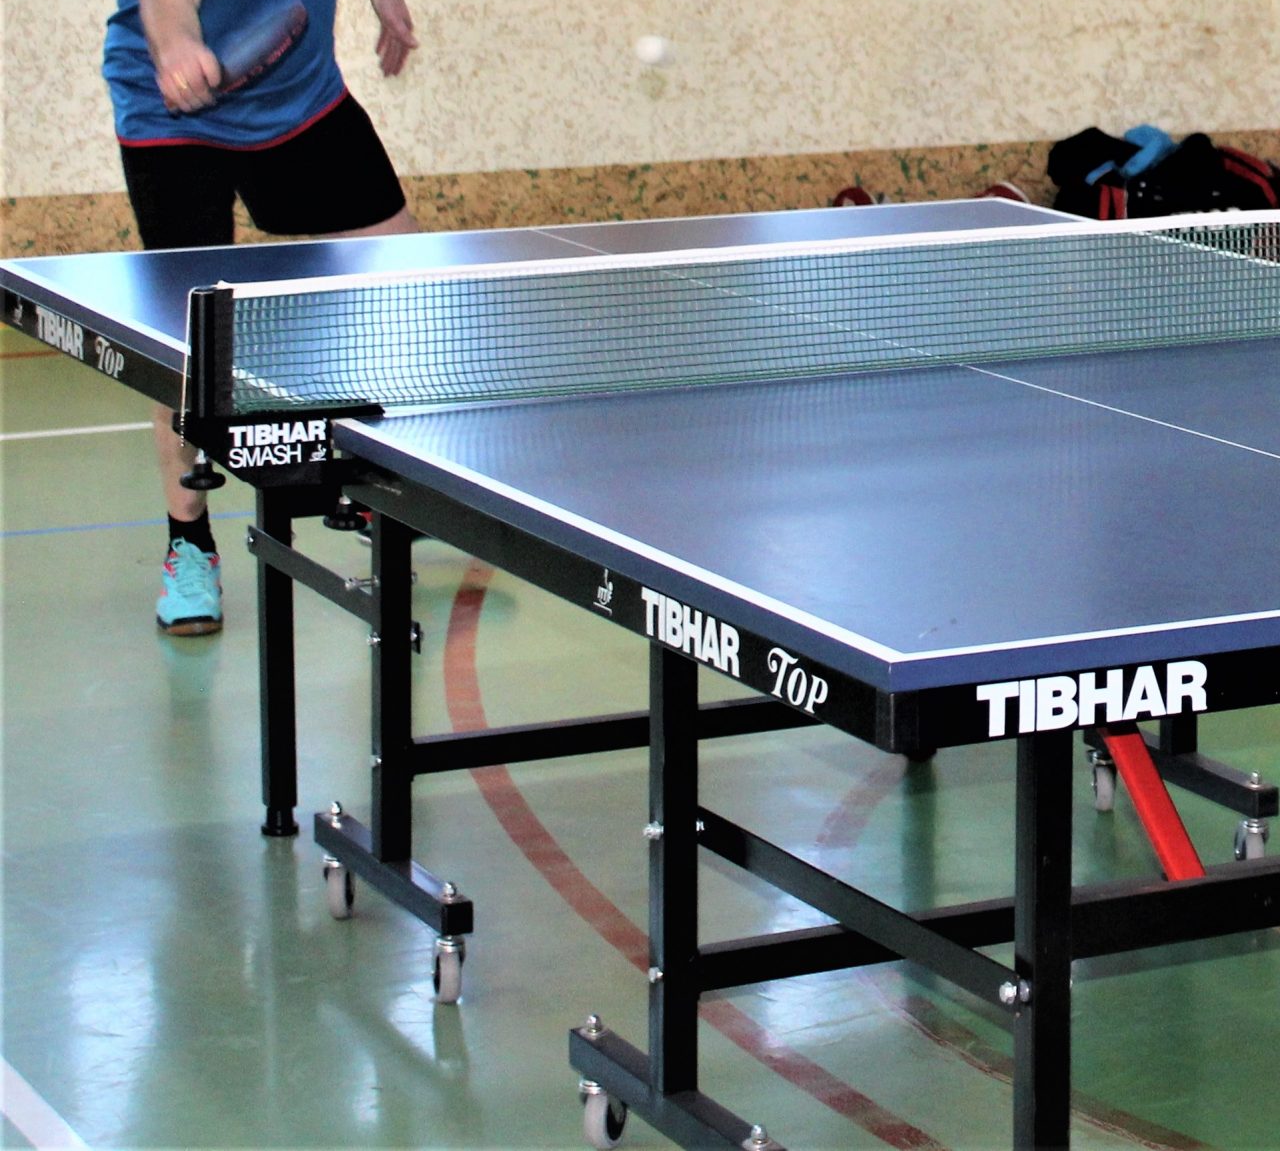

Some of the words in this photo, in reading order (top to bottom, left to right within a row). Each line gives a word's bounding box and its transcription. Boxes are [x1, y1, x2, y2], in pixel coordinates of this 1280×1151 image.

[36, 304, 84, 361] TIBHAR
[228, 420, 326, 447] TIBHAR
[228, 444, 301, 468] SMASH
[641, 586, 740, 678] TIBHAR
[767, 647, 828, 714] TOP
[976, 660, 1208, 738] TIBHAR
